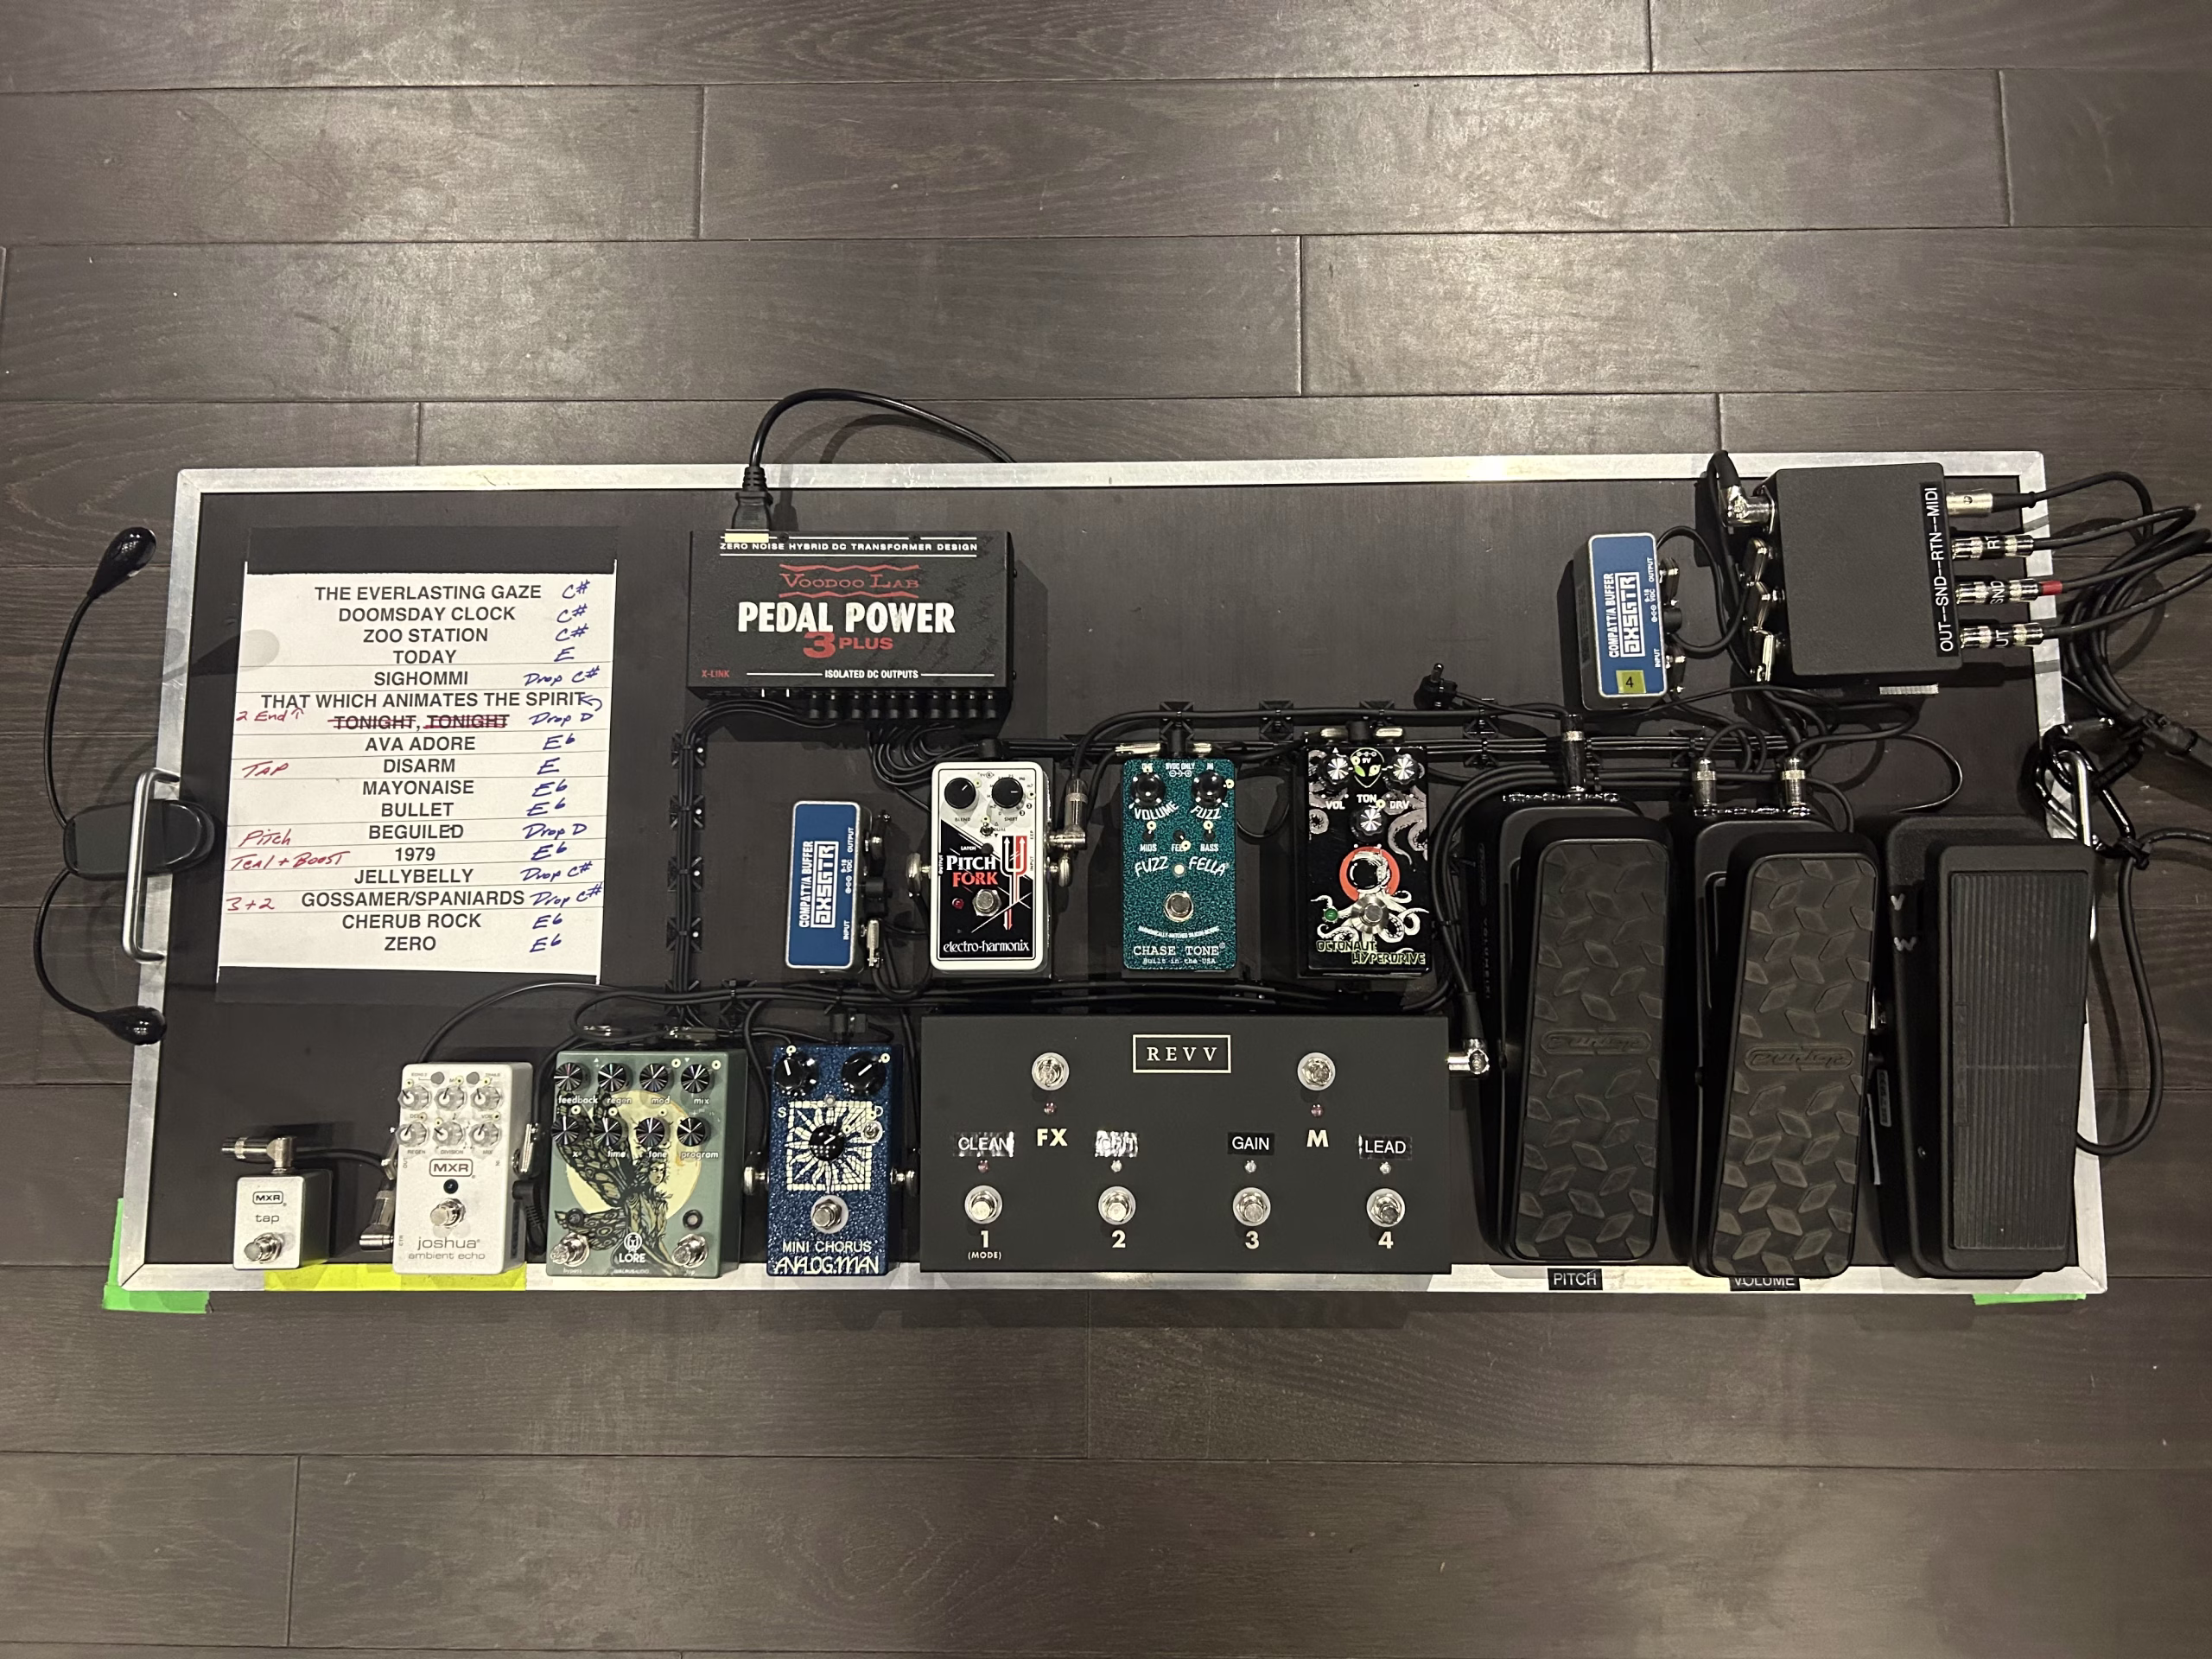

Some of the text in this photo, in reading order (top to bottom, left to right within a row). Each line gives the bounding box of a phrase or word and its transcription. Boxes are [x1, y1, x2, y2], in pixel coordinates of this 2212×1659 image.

[719, 542, 978, 552] ZERO NOISE HYBRID DC TRANSFORMER DESIGN
[315, 584, 542, 601] THE EVERLASTING GAZE
[561, 580, 591, 599] C#
[1603, 572, 1617, 607] BUFFER
[1990, 581, 2005, 605] SND
[338, 606, 516, 622] DOOMSDAY CLOCK
[556, 605, 588, 623] C#
[738, 601, 956, 633] PEDAL POWER
[363, 627, 488, 644] ZOO STATION
[555, 624, 589, 642] C#
[803, 632, 894, 658] 3 PLUS
[393, 650, 457, 664] TODAY
[554, 647, 575, 663] E
[373, 671, 469, 686] SIGHOMMI
[523, 666, 601, 687] Drop C#
[701, 670, 730, 679] X-LINK
[825, 670, 918, 680] ISOLATED DC OUTPUTS
[1625, 676, 1634, 688] 4
[261, 691, 587, 709] THAT WHICH ANIMATES THE SPIRIT
[236, 709, 287, 722] 2 End
[333, 714, 510, 732] TONIGHT, TONIGHT
[529, 710, 594, 726] Drop D
[365, 735, 476, 752] AVA ADORE
[242, 760, 289, 779] TAP
[383, 758, 456, 773] DISARM
[537, 757, 561, 775] E
[362, 779, 474, 796] MAYONAISE
[381, 802, 454, 817] BULLET
[1134, 800, 1179, 820] VOLUME
[1190, 804, 1222, 820] FUZZ
[1325, 800, 1345, 810] VOL
[1389, 800, 1410, 810] DRV
[368, 823, 464, 840] BEGUILED
[522, 823, 588, 840] Drop D
[395, 847, 436, 861] 1979
[1140, 843, 1157, 852] MIDS
[1200, 843, 1219, 852] BASS
[802, 841, 814, 875] BUFFER
[1135, 855, 1227, 877] FUZZ FELLA
[354, 868, 474, 885] JELLYBELLY
[520, 861, 594, 883] Drop C#
[952, 872, 998, 887] FORK
[301, 890, 525, 907] GOSSAMER/SPANIARDS
[529, 882, 603, 908] Drop C#
[226, 896, 242, 912] 3
[258, 898, 276, 910] 2
[341, 912, 482, 930] CHERUB ROCK
[384, 936, 437, 951] ZERO
[943, 938, 1030, 953] electro-harmonix
[1133, 945, 1219, 956] CHASE TONE
[1316, 940, 1377, 952] OCTONAUT
[1351, 951, 1426, 964] HYPERDRIVE
[1146, 1046, 1217, 1062] REVV
[558, 1095, 599, 1104] feedback
[607, 1096, 632, 1106] regen
[651, 1096, 671, 1104] mod
[694, 1096, 710, 1105] mix
[958, 1136, 1009, 1151] CLEAN
[1036, 1128, 1068, 1147] FX
[1231, 1135, 1270, 1151] GAIN
[1306, 1129, 1329, 1148] M
[607, 1150, 626, 1159] time
[649, 1150, 667, 1159] tone
[681, 1151, 719, 1160] program
[1364, 1140, 1407, 1155] LEAD
[433, 1163, 469, 1173] MXR
[256, 1193, 281, 1203] MXR
[255, 1214, 280, 1225] tap
[417, 1236, 477, 1250] joshua
[782, 1240, 872, 1253] MINI CHORUS
[980, 1230, 989, 1248] 1
[1111, 1230, 1126, 1249] 2
[1245, 1230, 1260, 1249] 3
[1377, 1231, 1394, 1249] 4
[619, 1253, 646, 1263] LORE
[967, 1250, 1002, 1261] (MODE)
[1553, 1272, 1598, 1287] PITCH
[1733, 1277, 1796, 1287] VOLUME
